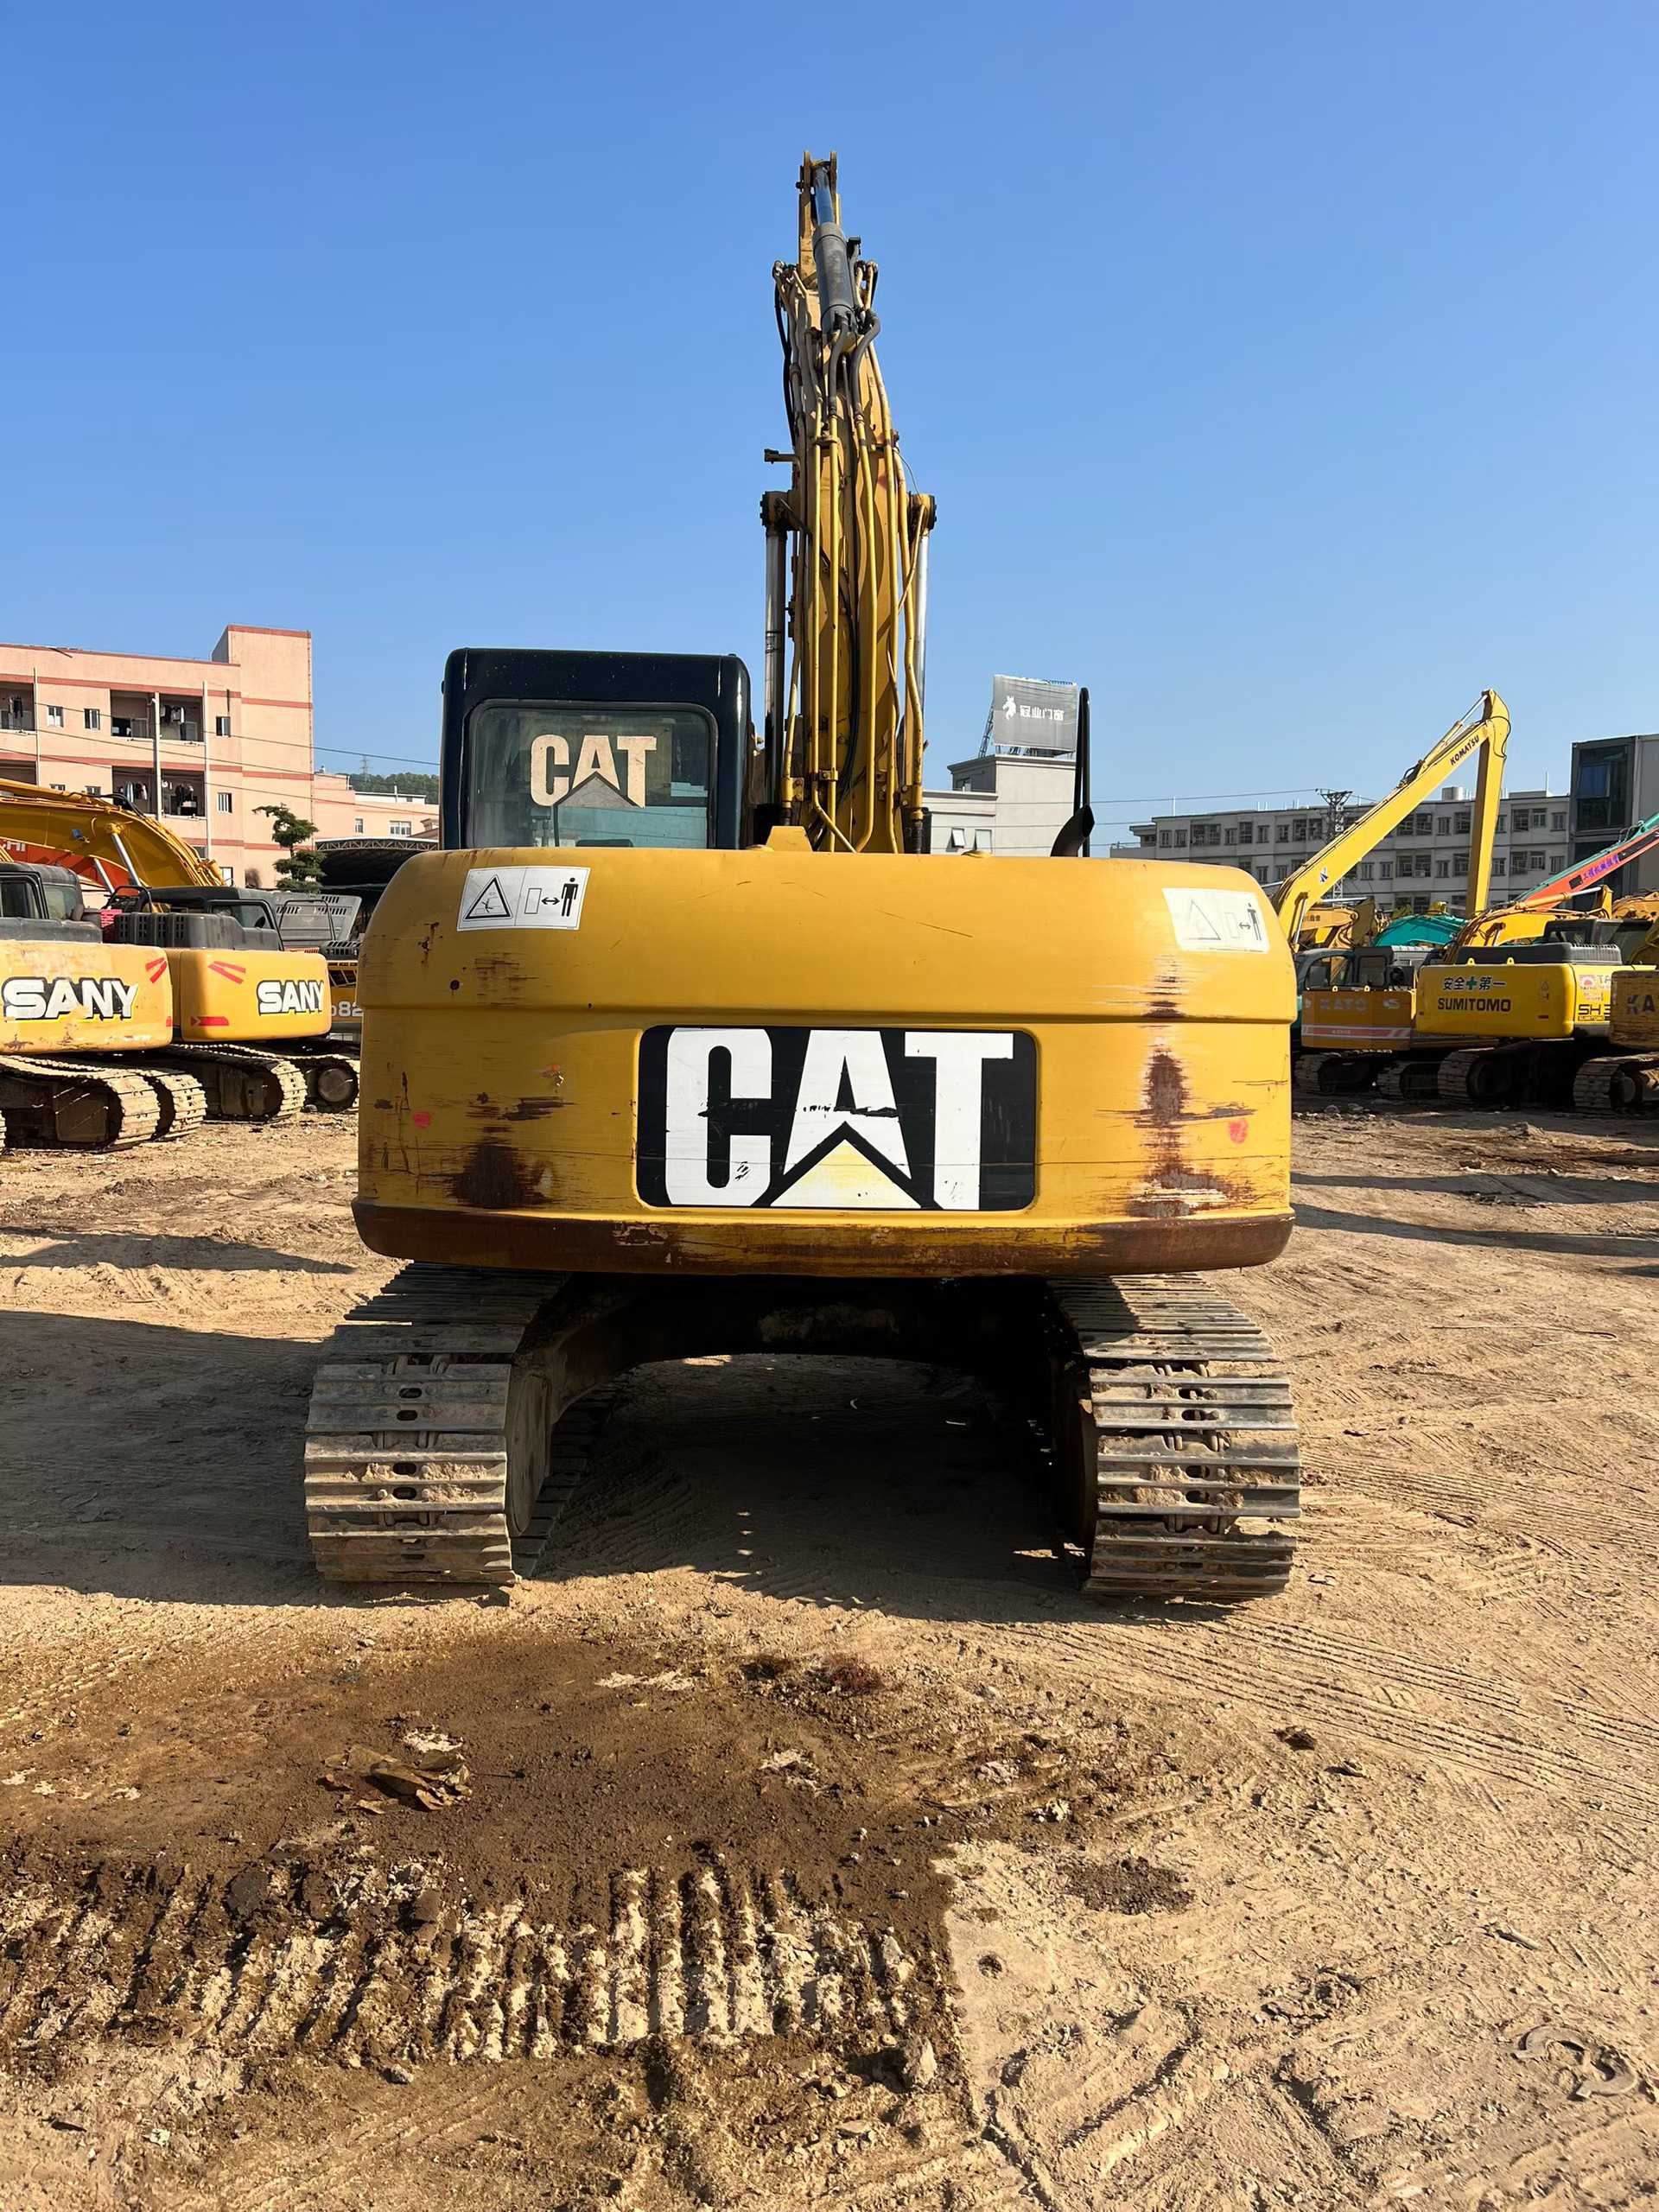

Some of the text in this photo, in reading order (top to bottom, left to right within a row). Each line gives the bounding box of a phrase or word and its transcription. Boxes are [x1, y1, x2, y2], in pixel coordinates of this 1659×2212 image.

[1450, 734, 1479, 765] KOMATSU
[530, 734, 657, 809] CAT
[3, 977, 139, 1020] SANY
[257, 980, 325, 1015] SANY
[1438, 998, 1511, 1012] SUMITOMO
[665, 1027, 1014, 1210] CAT
